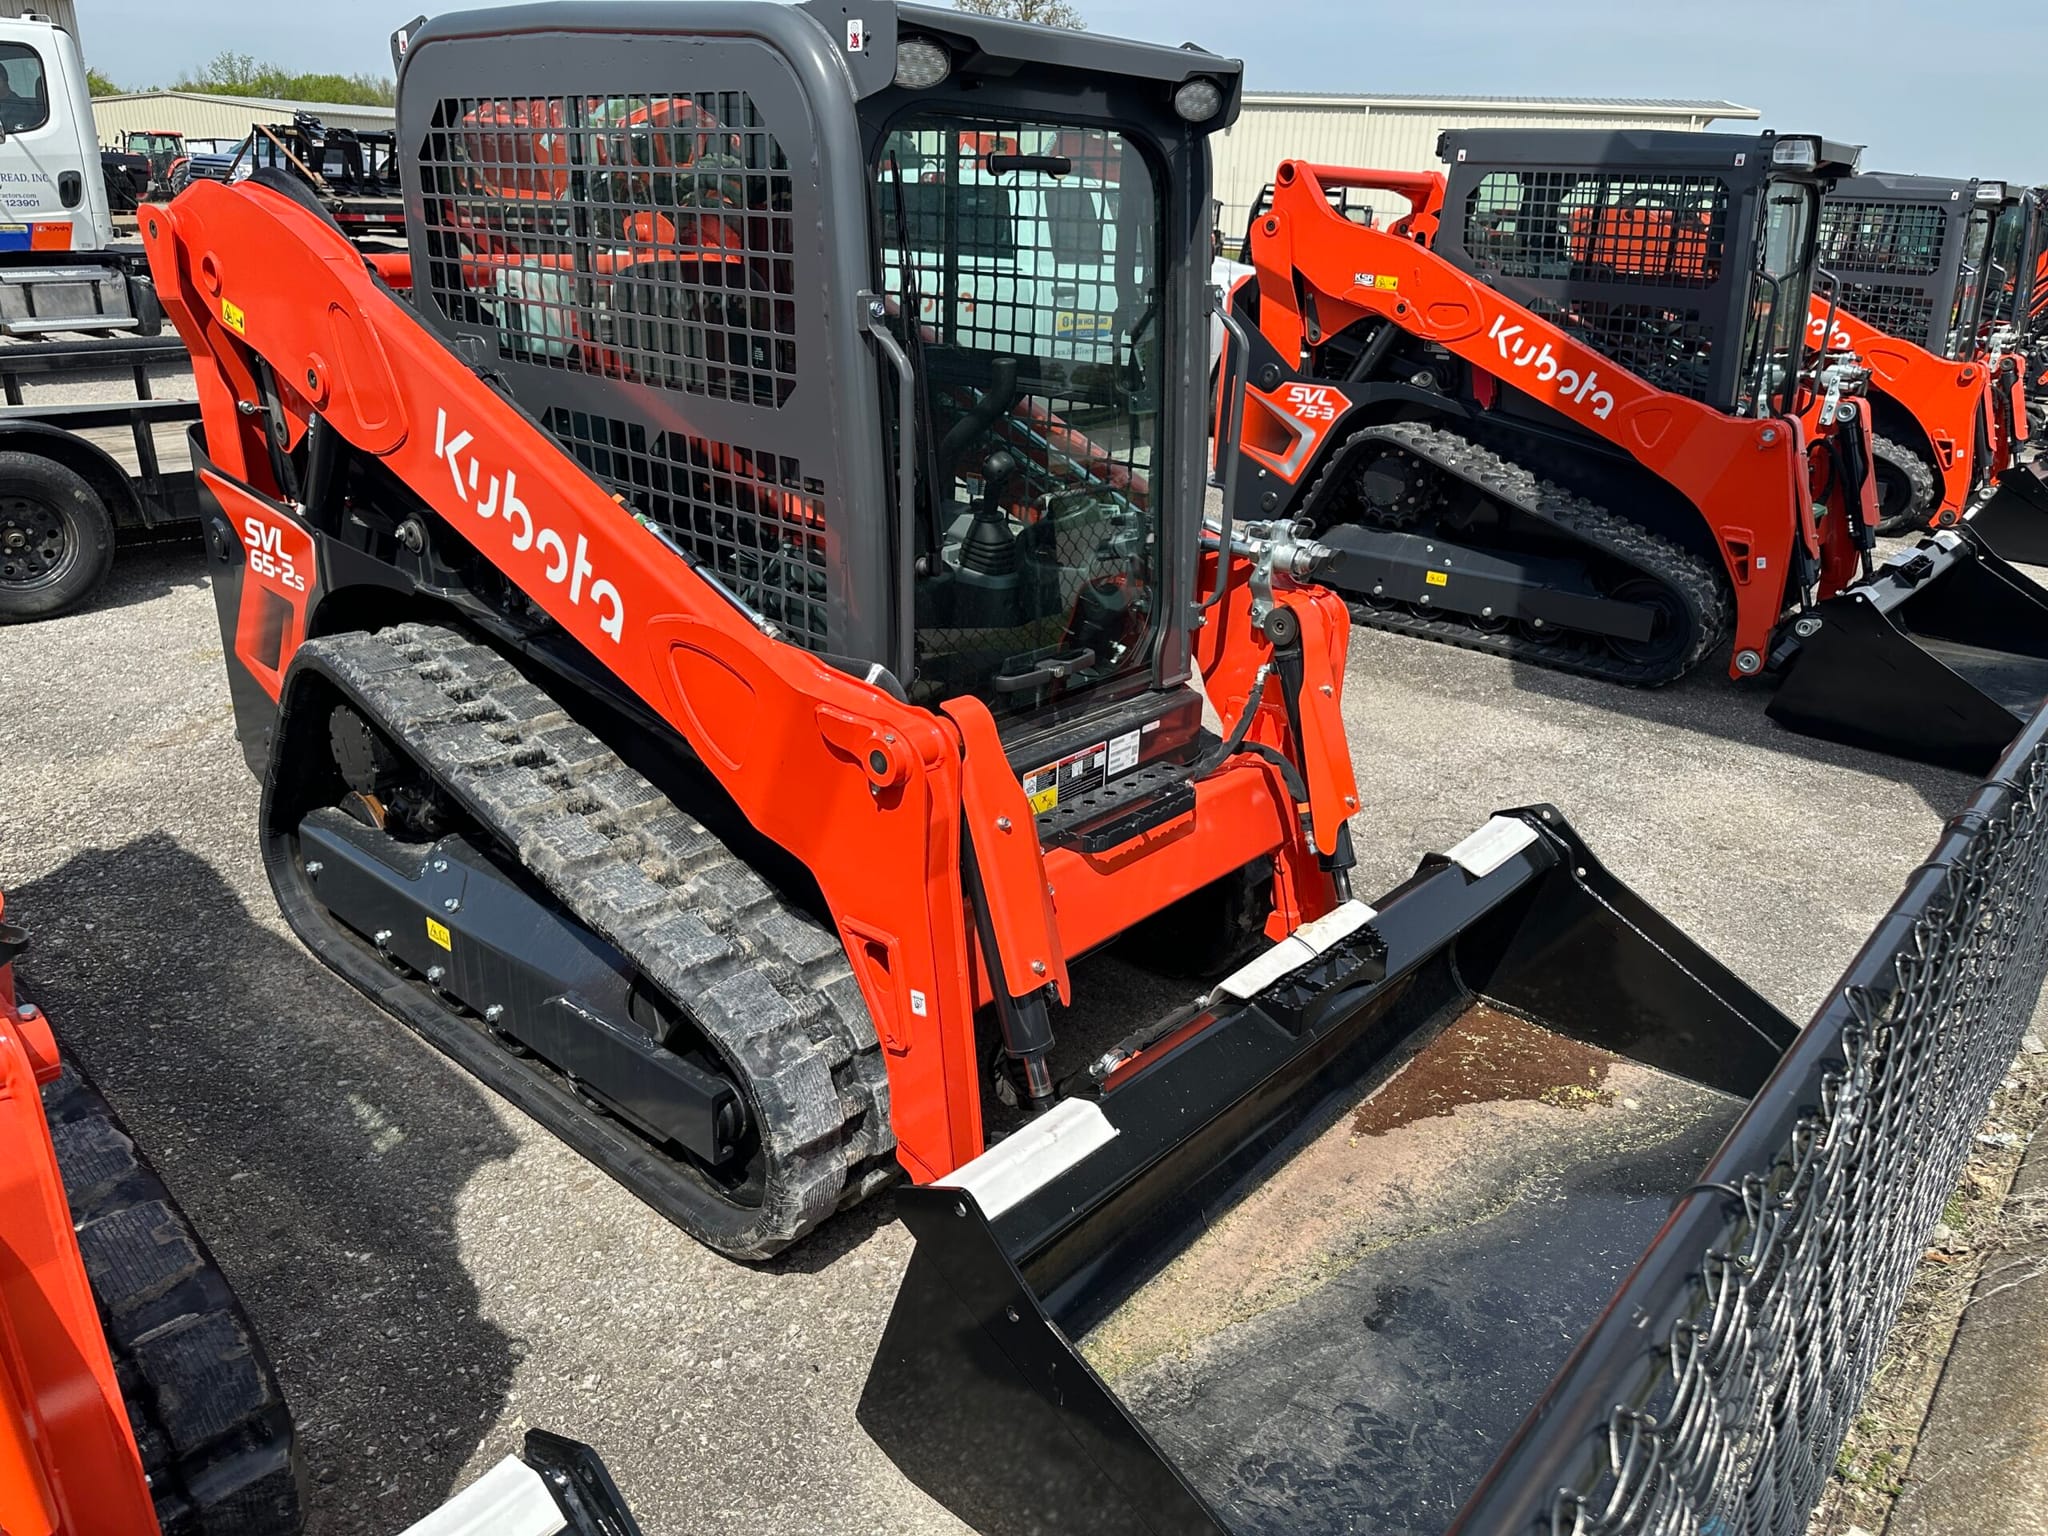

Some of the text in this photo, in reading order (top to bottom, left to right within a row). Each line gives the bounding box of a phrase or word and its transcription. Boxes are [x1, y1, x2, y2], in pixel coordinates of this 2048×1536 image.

[5, 199, 40, 207] 123901
[1488, 314, 1614, 420] Kubota
[1287, 386, 1333, 406] SVL
[1295, 404, 1335, 420] 75-3
[244, 517, 292, 562] SVL
[435, 407, 624, 644] Kubota
